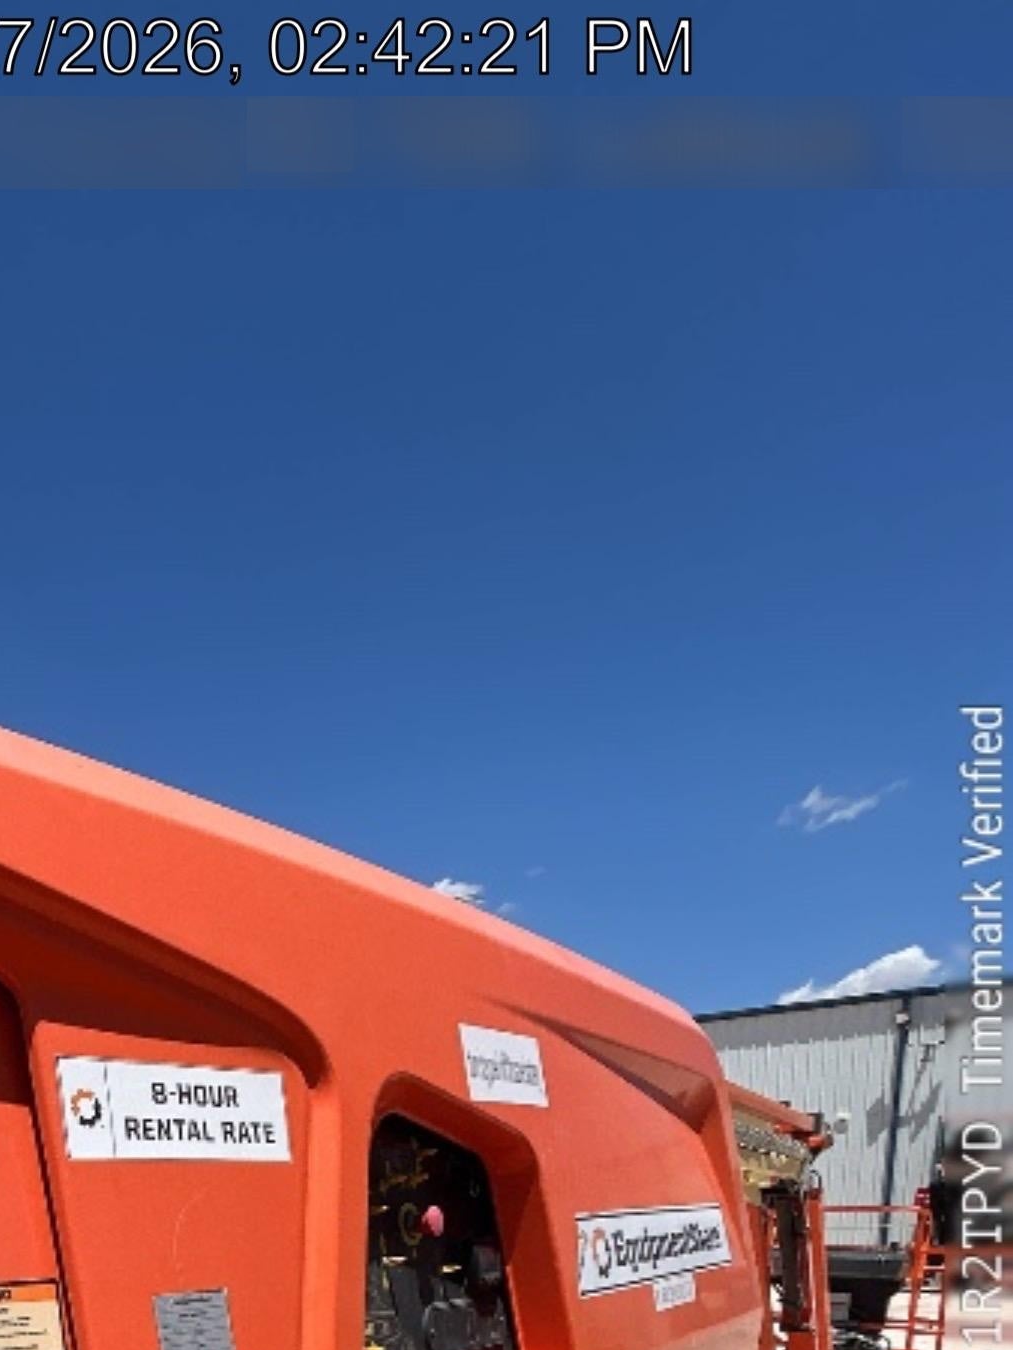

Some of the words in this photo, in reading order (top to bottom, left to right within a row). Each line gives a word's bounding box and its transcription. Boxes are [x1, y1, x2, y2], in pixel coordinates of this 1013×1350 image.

[150, 1082, 240, 1108] 8-HOUR
[124, 1116, 215, 1143] RENTAL
[220, 1121, 277, 1144] RATE
